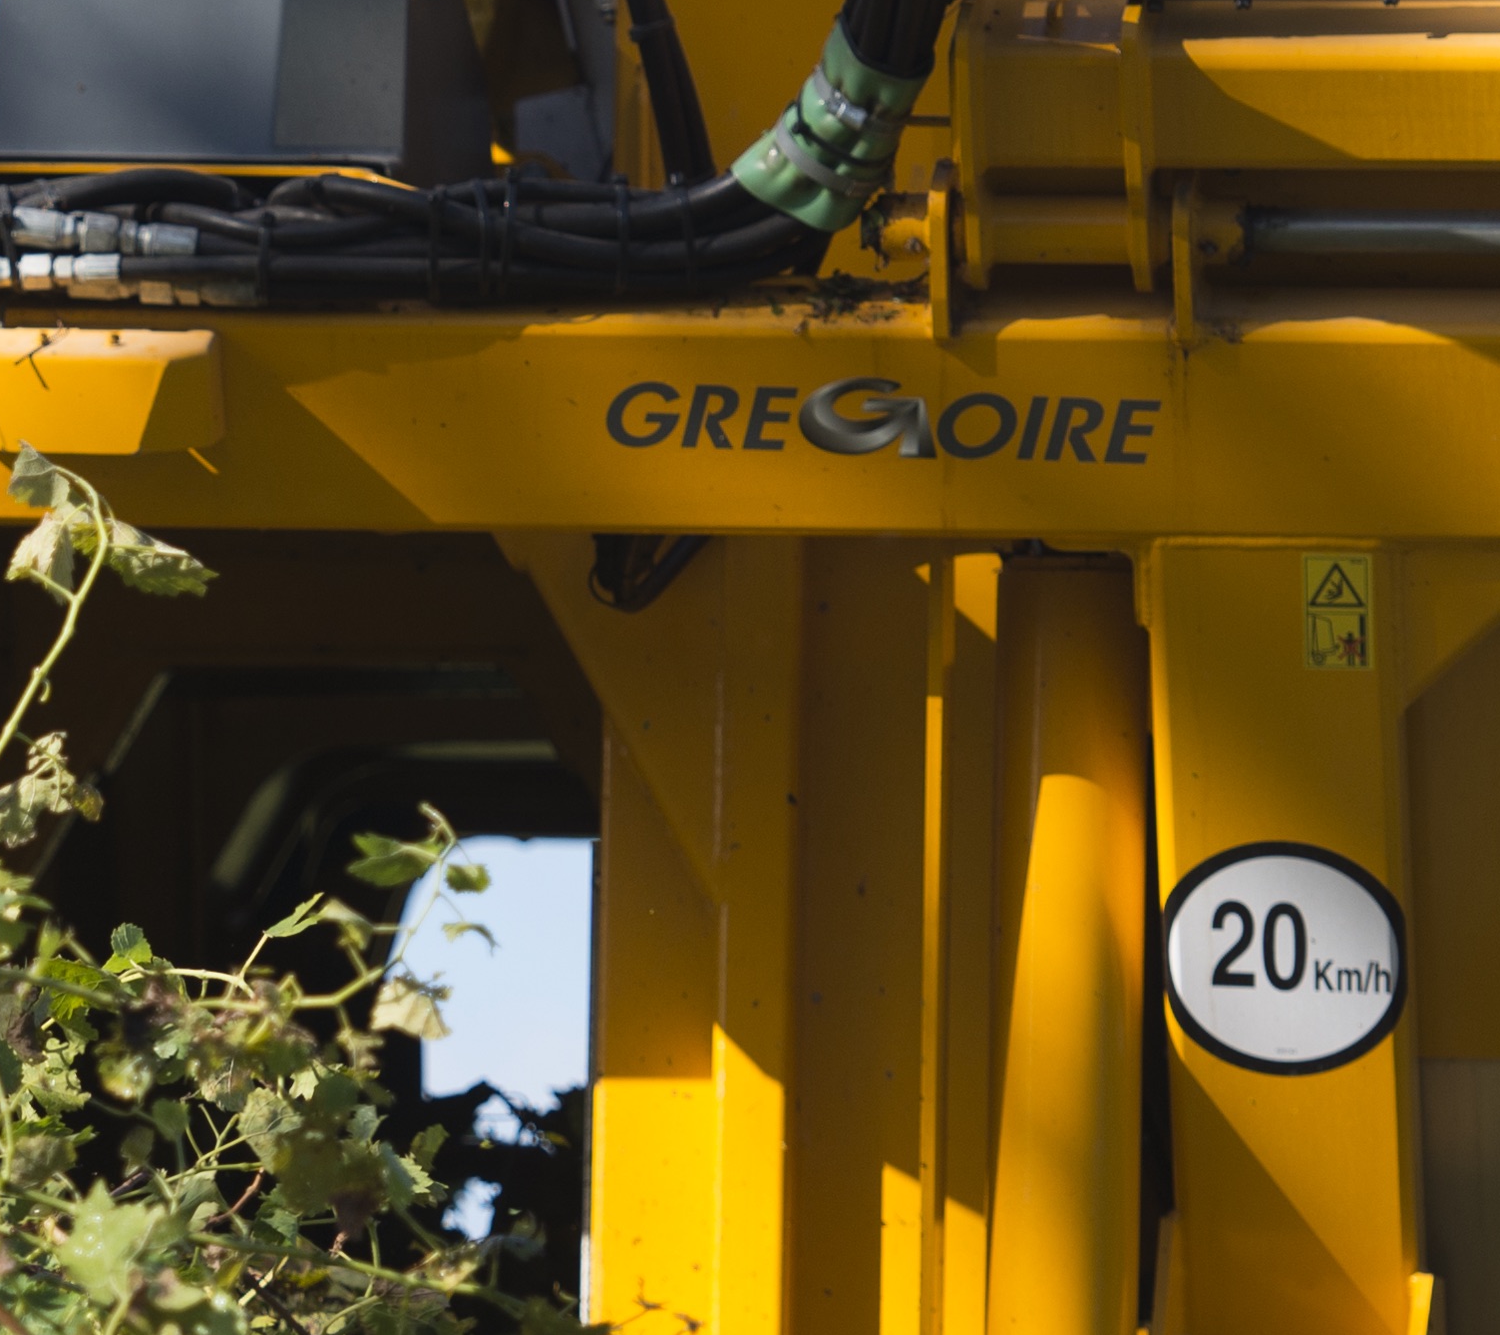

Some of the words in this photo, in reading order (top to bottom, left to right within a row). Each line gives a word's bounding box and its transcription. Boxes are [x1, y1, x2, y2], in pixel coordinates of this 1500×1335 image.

[605, 377, 1162, 463] GREGOIRE
[1211, 900, 1308, 992] 20
[1314, 959, 1392, 996] Km/h
